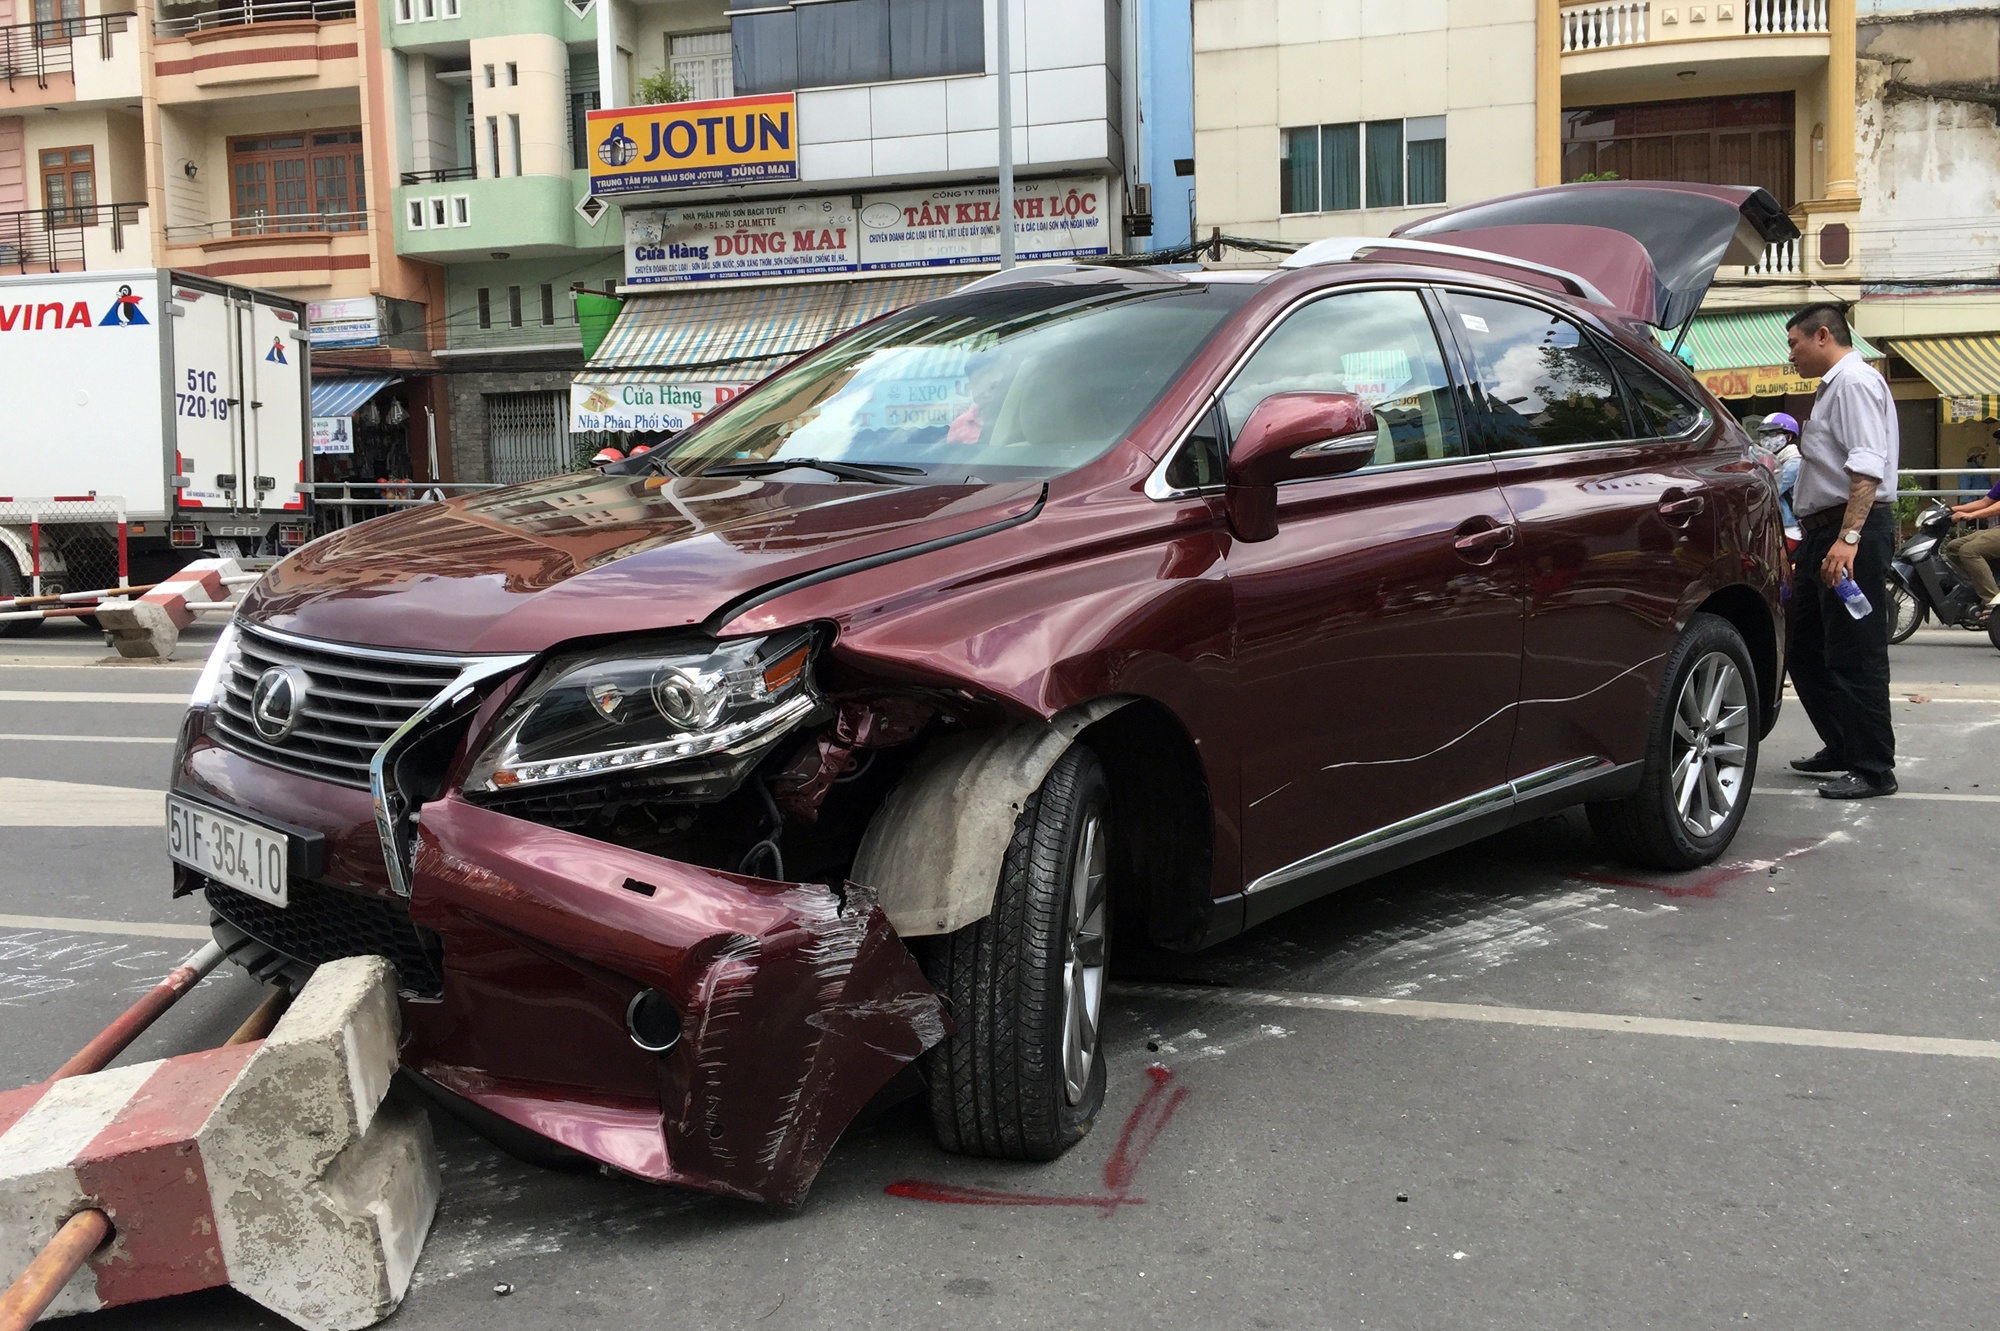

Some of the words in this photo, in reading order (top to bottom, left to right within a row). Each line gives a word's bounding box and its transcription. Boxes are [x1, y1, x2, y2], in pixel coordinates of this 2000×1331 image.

[644, 112, 790, 162] JOTUN
[596, 179, 622, 188] TRUNG
[624, 176, 641, 185] TÂM
[643, 175, 659, 184] PHA
[661, 171, 678, 182] MÀU
[680, 171, 696, 181] SƠN
[697, 170, 723, 180] JOTUN
[732, 164, 764, 177] DŨNG
[768, 164, 790, 175] MAI
[932, 190, 962, 198] CÔNG
[977, 188, 1000, 196] TNHH
[682, 210, 696, 220] NHÀ
[698, 210, 714, 220] PHÂN
[733, 208, 746, 218] SƠN
[903, 200, 950, 228] TÂN
[1050, 189, 1096, 220] LỘC
[709, 222, 718, 230] 51
[726, 220, 734, 229] 53
[738, 218, 776, 228] CALMETTE
[635, 243, 665, 261] Cửa
[669, 243, 709, 260] Hàng
[714, 229, 786, 256] DŨNG
[792, 228, 847, 252] MAI
[187, 368, 217, 394] 51C
[1354, 383, 1386, 394] MAI
[1755, 384, 1767, 394] GIA
[622, 384, 654, 406] Cửa
[660, 385, 702, 409] Hàng
[909, 385, 948, 402] EXPO
[578, 415, 600, 428] Nhà
[604, 415, 631, 428] Phân
[634, 412, 659, 428] Phối
[662, 413, 683, 428] Sơn
[902, 409, 948, 424] JOTUN
[220, 526, 260, 536] FAP
[171, 804, 281, 895] 51F-354.10
